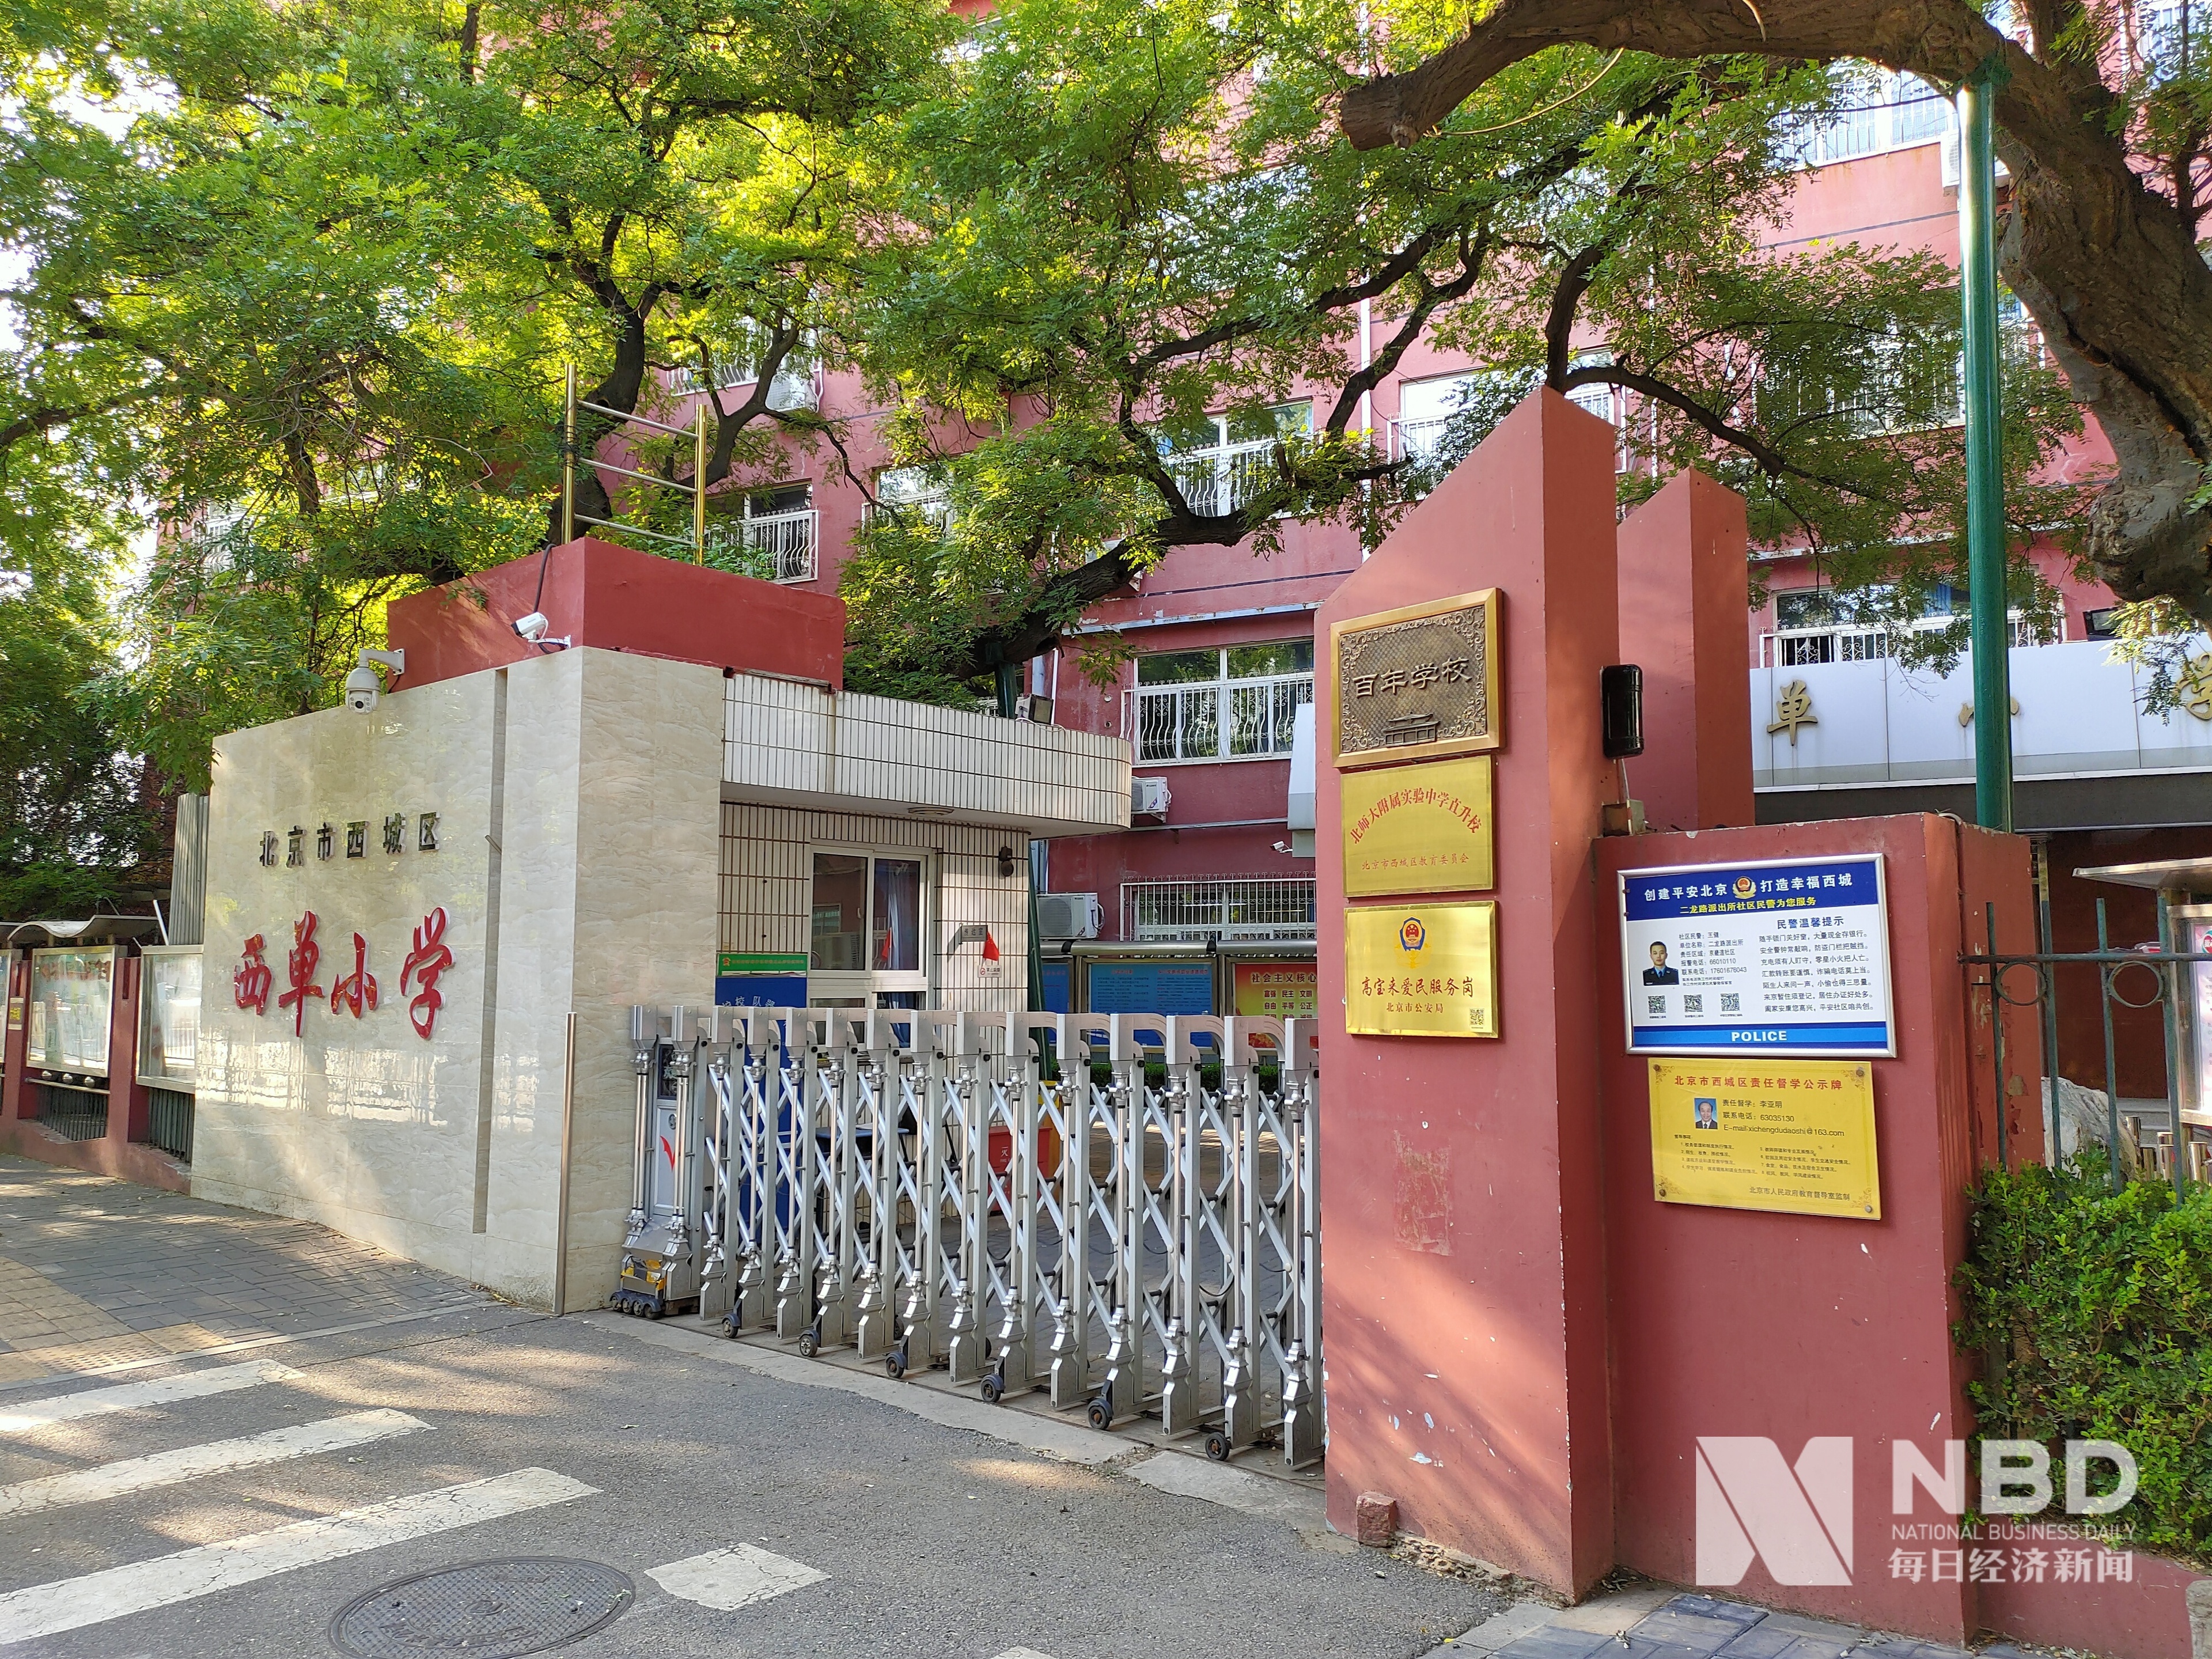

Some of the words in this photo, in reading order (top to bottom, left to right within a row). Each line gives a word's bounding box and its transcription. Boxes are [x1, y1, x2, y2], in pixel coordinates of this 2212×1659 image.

[1353, 657, 1472, 699] 百年学校
[1349, 787, 1482, 844] 北师大附属实验中学直升校
[259, 812, 441, 867] 北京市西城区
[1362, 853, 1469, 870] 北京市西城区教育委员会
[1644, 883, 1727, 902] 创建平安北京
[1760, 873, 1853, 893] 打造幸福西城
[1680, 896, 1816, 914] 二龙路派出所社区民警为您服务
[1777, 916, 1844, 929] 民警温馨提示
[233, 907, 455, 1039] 西单小学
[1252, 974, 1316, 983] 社会主义核心
[1362, 976, 1474, 997] 高宝来爱民服务岗
[1386, 1002, 1444, 1013] 北京市公安局
[1731, 1031, 1787, 1042] POLICE
[1675, 1075, 1843, 1090] 北京市西城区责任督学公示牌
